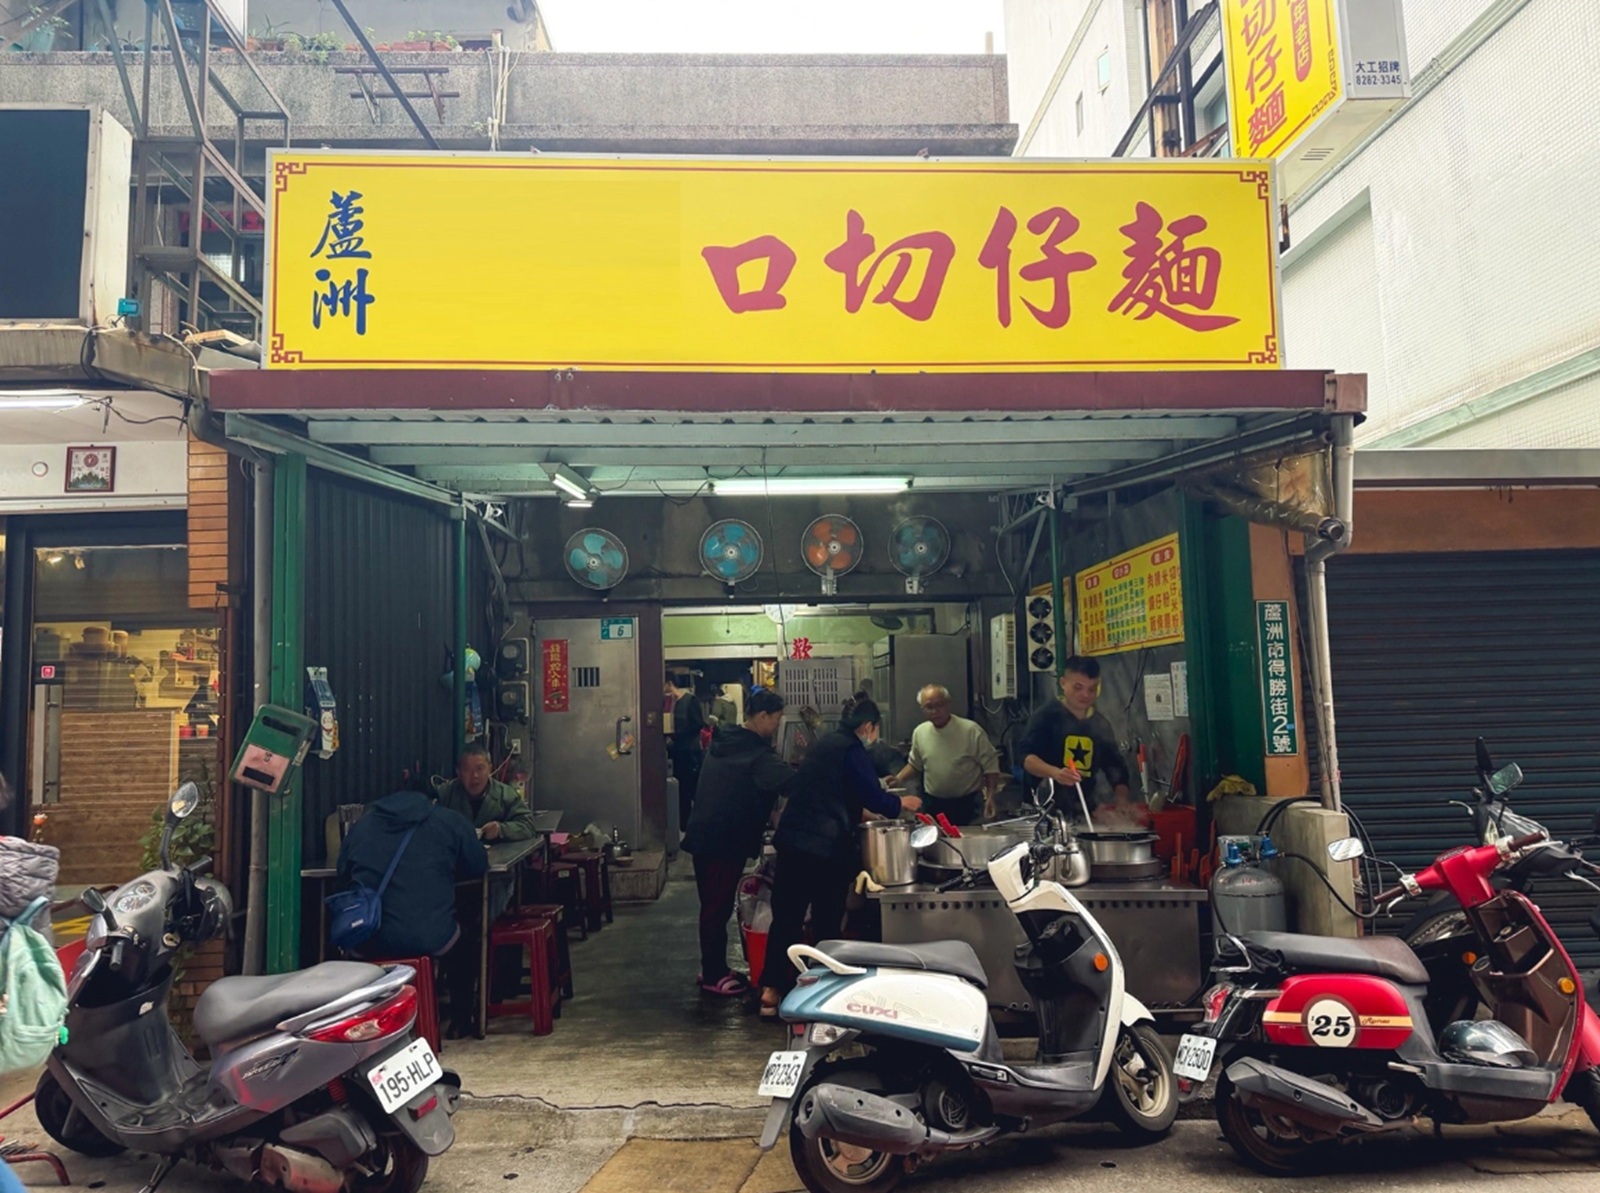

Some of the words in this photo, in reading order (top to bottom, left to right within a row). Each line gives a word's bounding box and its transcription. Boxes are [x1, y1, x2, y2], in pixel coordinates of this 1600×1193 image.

[310, 191, 375, 335] 蘆洲
[701, 201, 1241, 332] 口切仔麵
[617, 625, 624, 637] 6
[1264, 604, 1292, 752] 蘆洲市得勝街2號
[379, 1052, 434, 1104] 195-HLP
